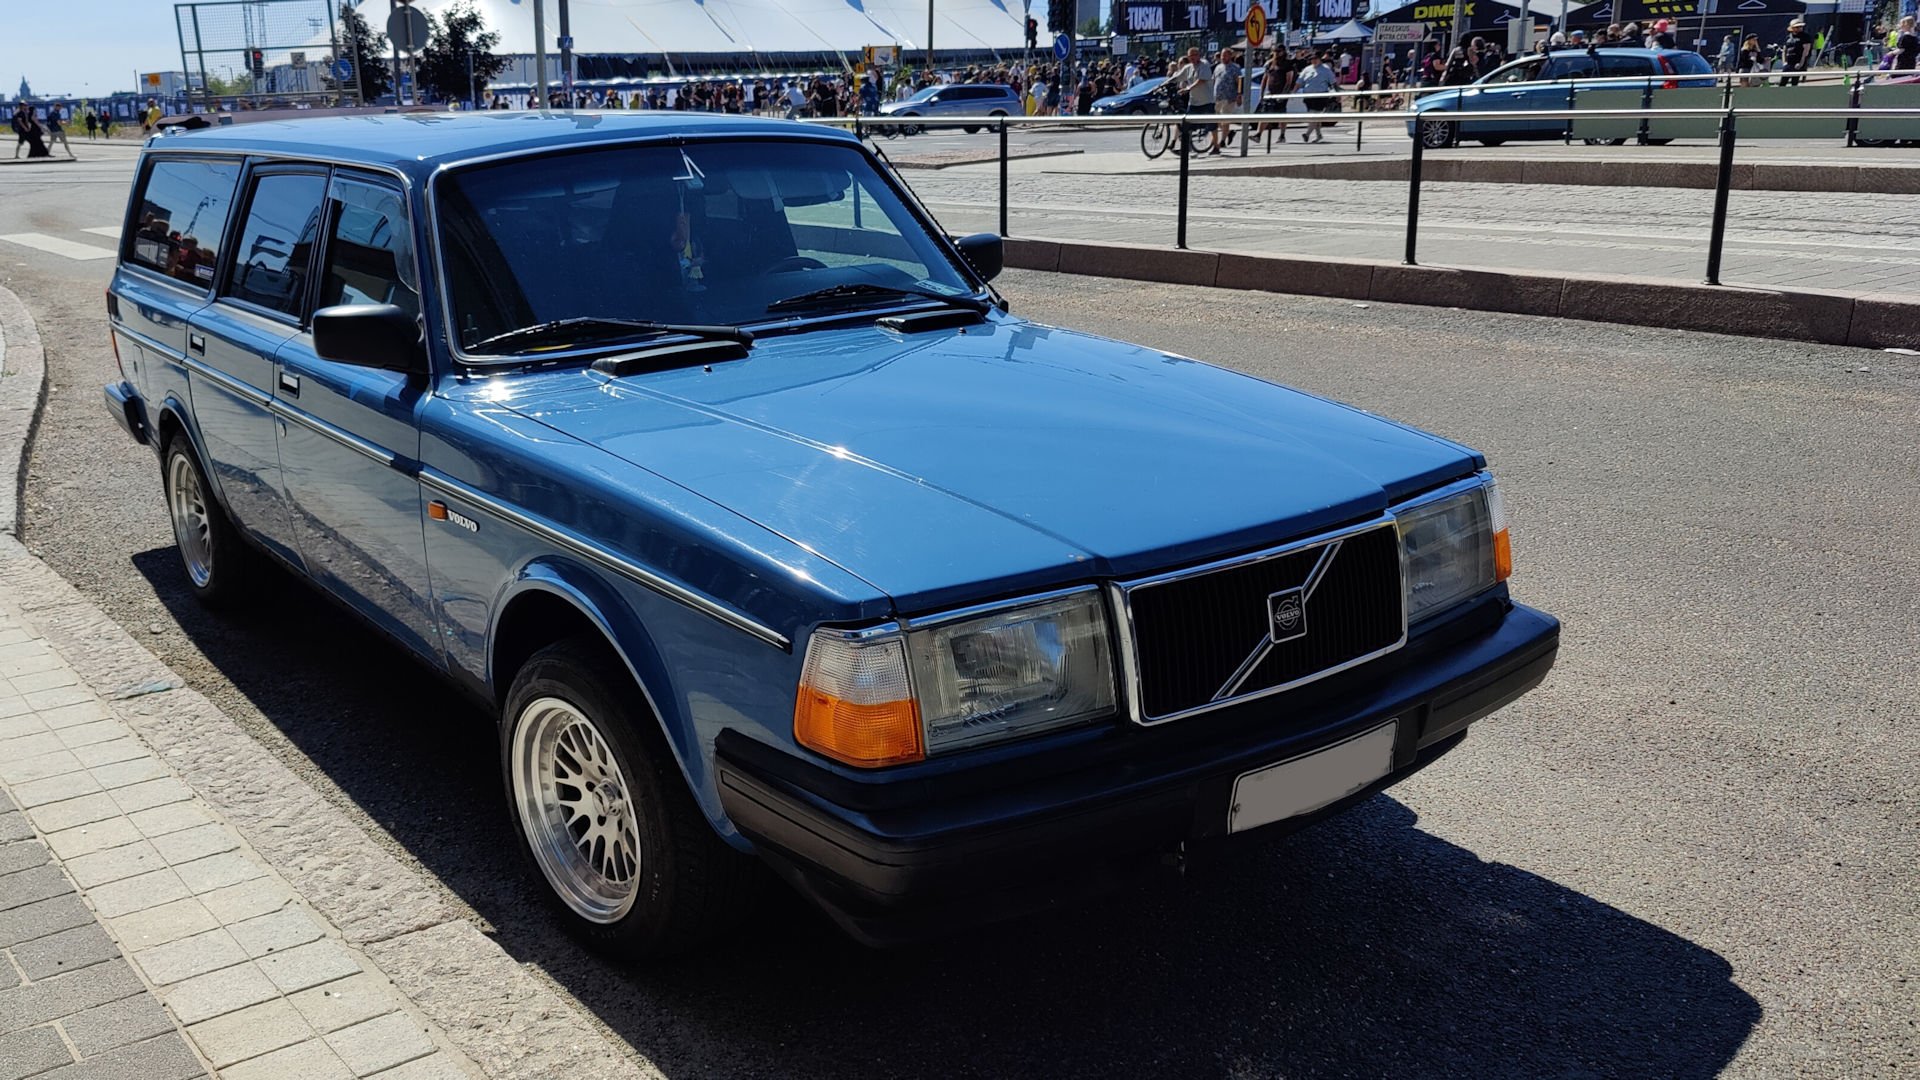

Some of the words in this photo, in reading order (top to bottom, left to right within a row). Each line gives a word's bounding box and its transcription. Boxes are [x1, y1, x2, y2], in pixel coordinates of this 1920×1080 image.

[1126, 6, 1163, 31] TUSKA
[1219, 0, 1279, 22] TUKA
[1317, 0, 1352, 18] TUSKA
[447, 510, 478, 532] VOLVO
[1276, 610, 1300, 620] VOLVO
